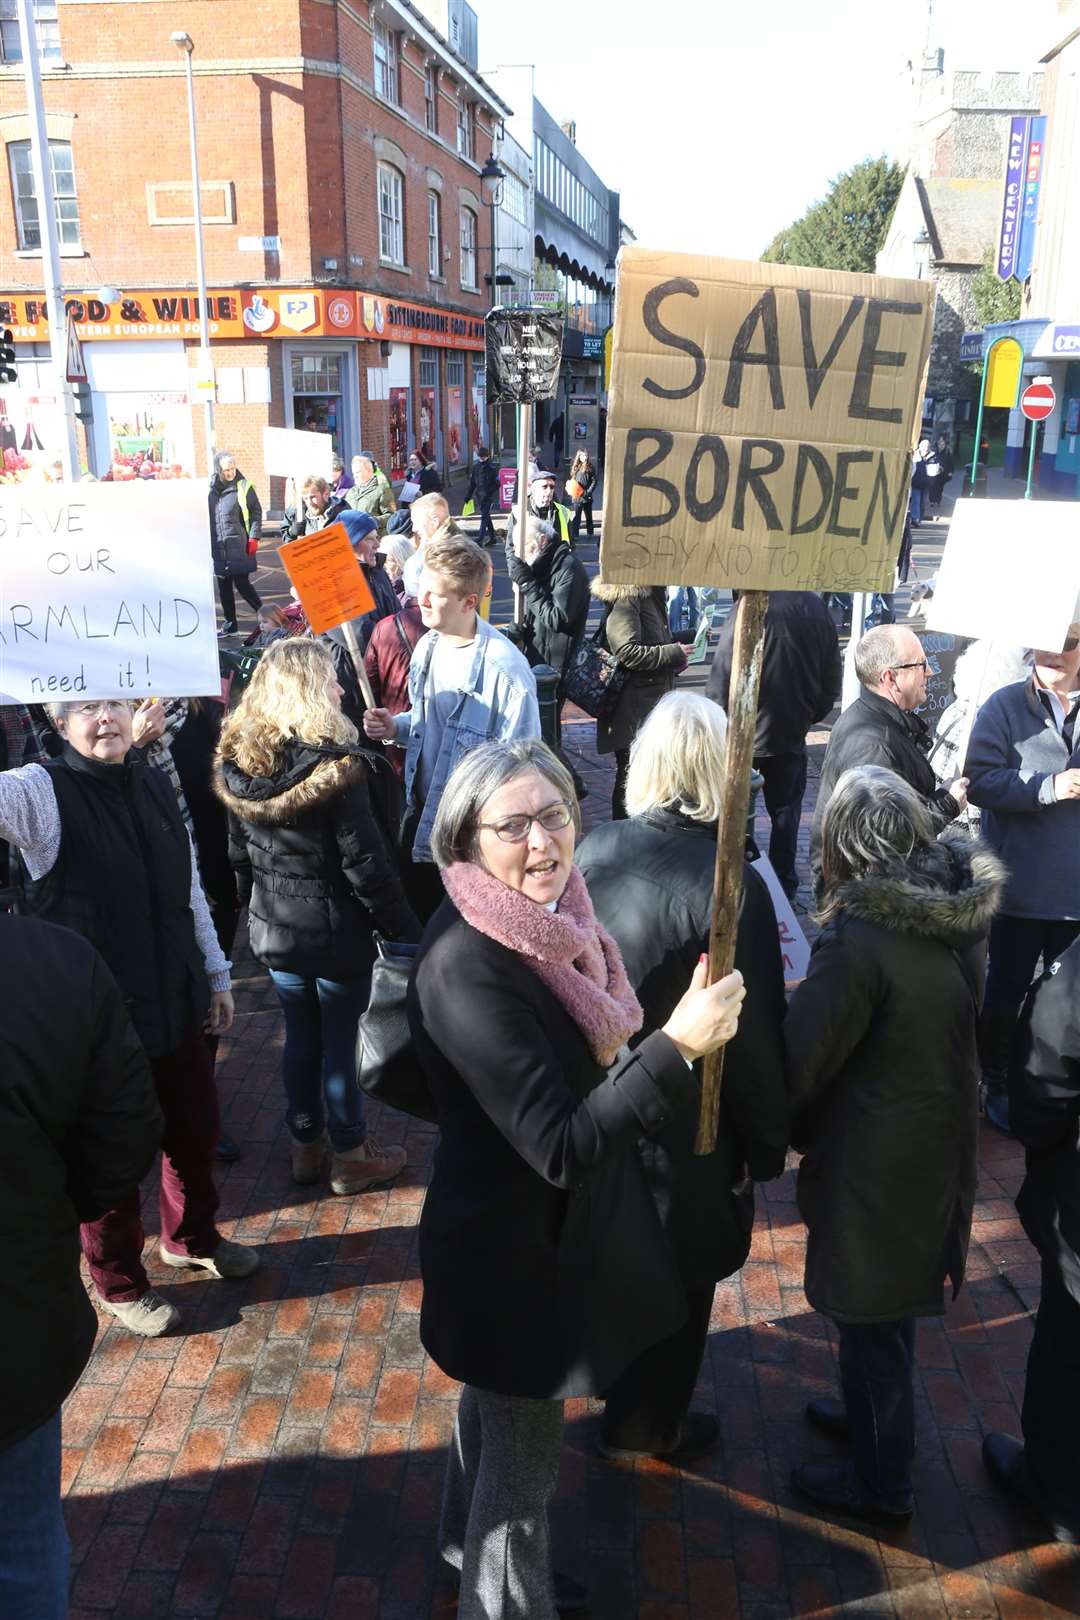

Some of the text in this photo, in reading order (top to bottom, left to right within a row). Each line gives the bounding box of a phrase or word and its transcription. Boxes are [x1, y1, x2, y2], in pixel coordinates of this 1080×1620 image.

[1000, 133, 1023, 270] NEW CENTURY
[121, 299, 146, 322] &
[387, 303, 449, 333] SITTINGBOURNE
[451, 317, 467, 336] FOOD
[13, 326, 37, 336] VEG
[114, 323, 181, 335] EUROPEAN
[184, 322, 219, 334] FOD
[642, 276, 923, 424] SAVE
[622, 428, 911, 545] BORDEN
[47, 548, 116, 575] OUR
[623, 533, 699, 573] SAY
[704, 543, 752, 576] NO
[764, 545, 799, 576] TO
[796, 577, 880, 590] HOUSES
[31, 664, 87, 693] need
